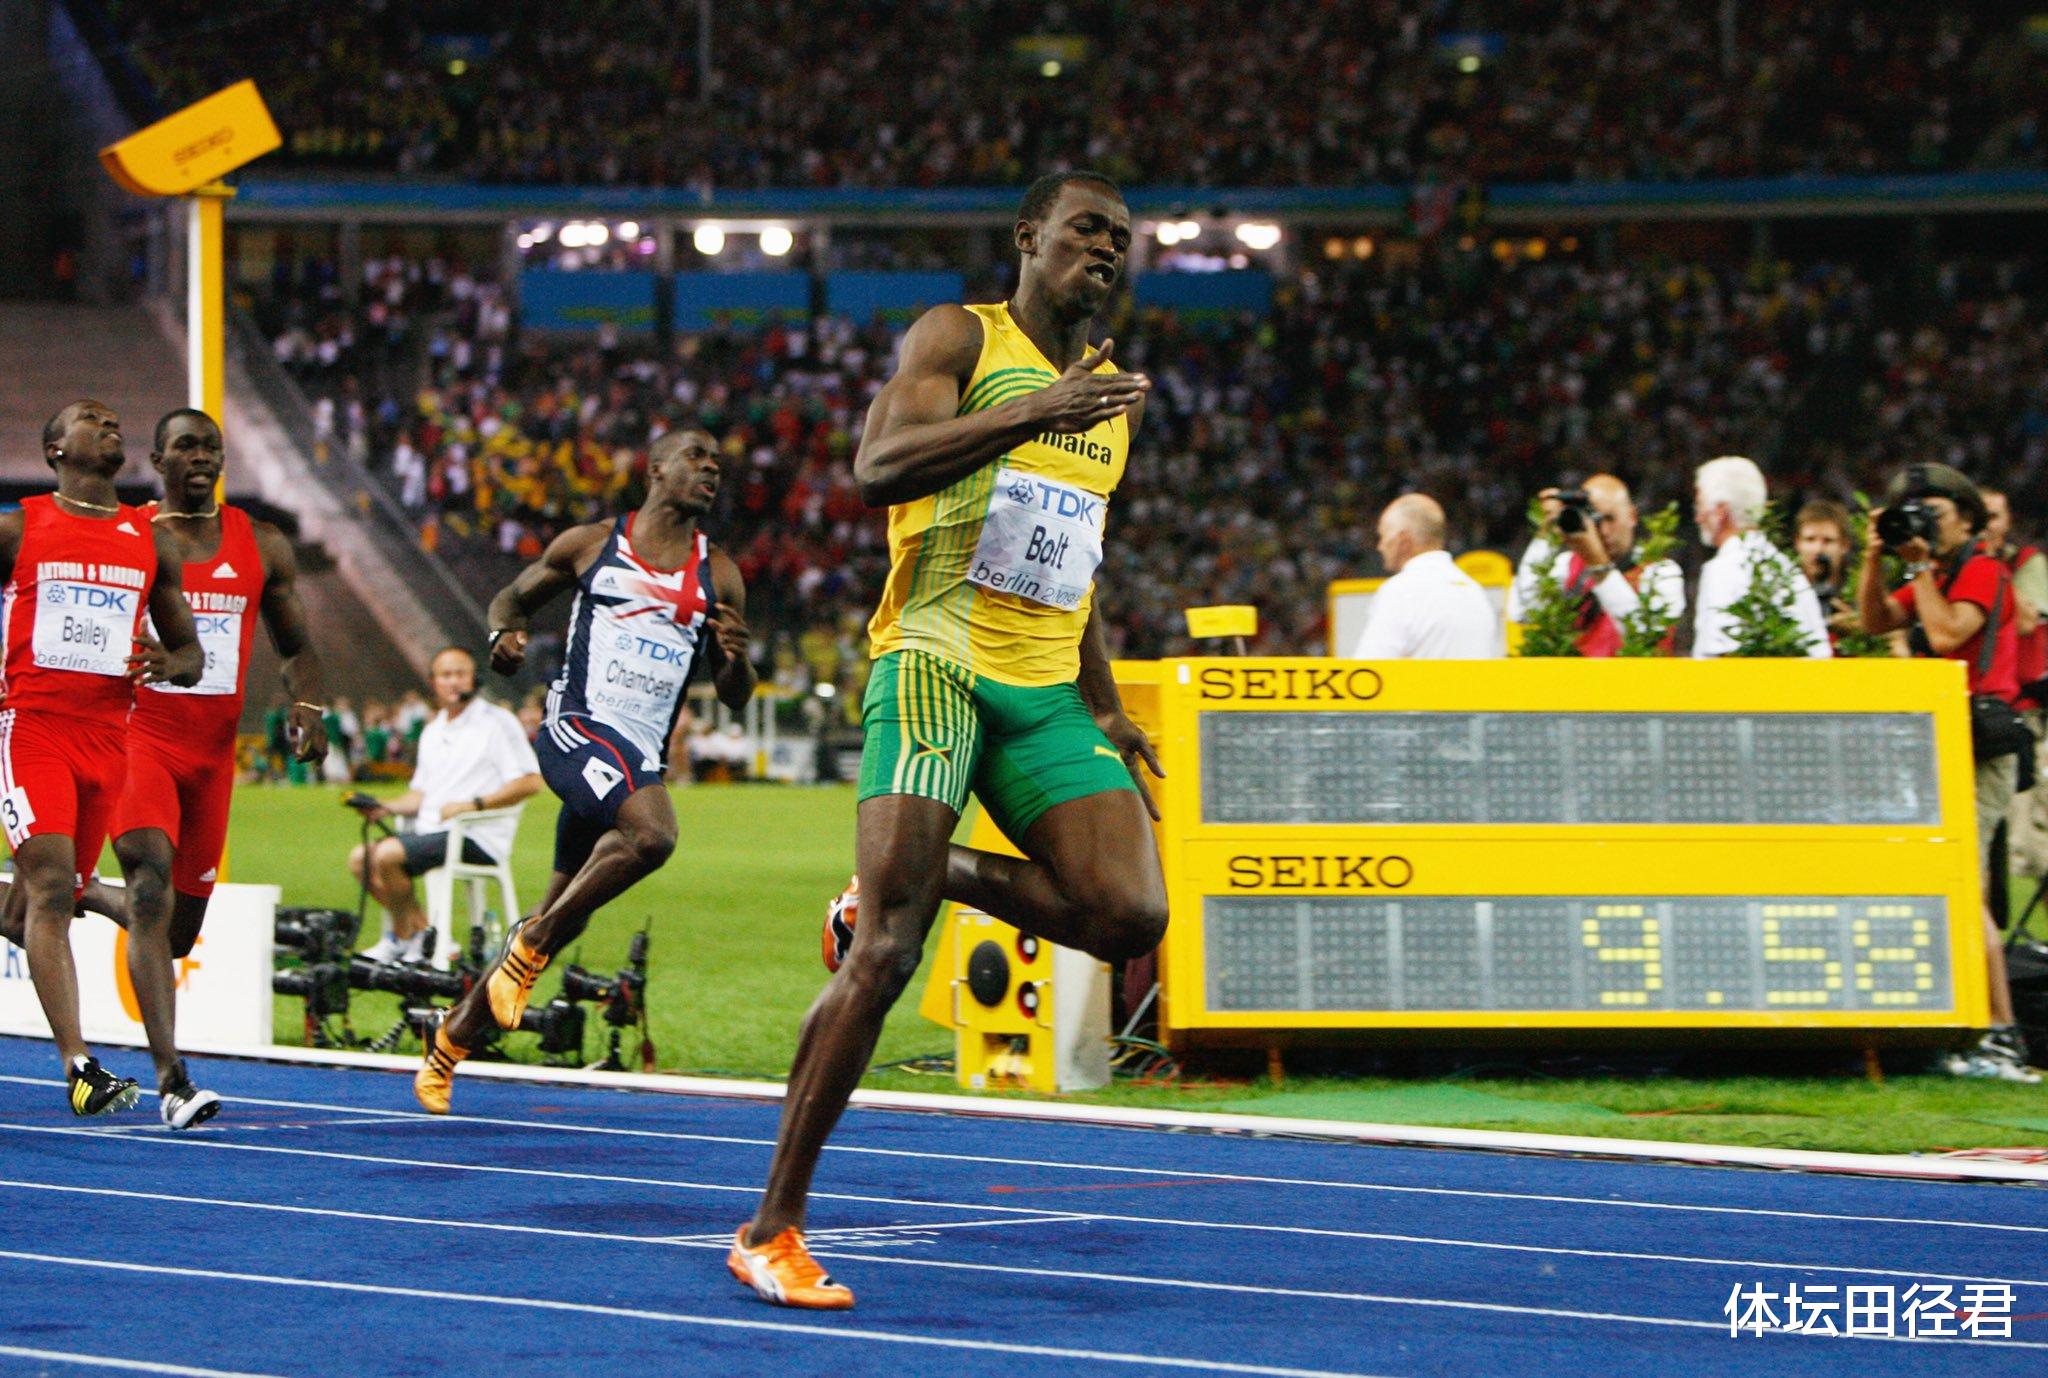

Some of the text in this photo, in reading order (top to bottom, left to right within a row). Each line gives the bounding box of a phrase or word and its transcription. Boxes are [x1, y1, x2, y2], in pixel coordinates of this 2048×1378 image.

[1033, 432, 1112, 466] maica
[1037, 482, 1096, 526] TDK
[1025, 525, 1069, 570] Bolt
[973, 561, 1040, 597] berlin
[67, 586, 127, 612] TDK
[62, 616, 110, 653] Bailey
[193, 617, 230, 634] DK
[36, 651, 89, 669] berlin
[636, 637, 687, 667] TDK
[606, 659, 674, 699] Chambers
[1200, 668, 1383, 701] SEIKO
[594, 690, 641, 713] berlin
[2, 798, 19, 830] 3
[1228, 855, 1414, 889] SEIKO
[1582, 904, 1934, 1005] 9.58
